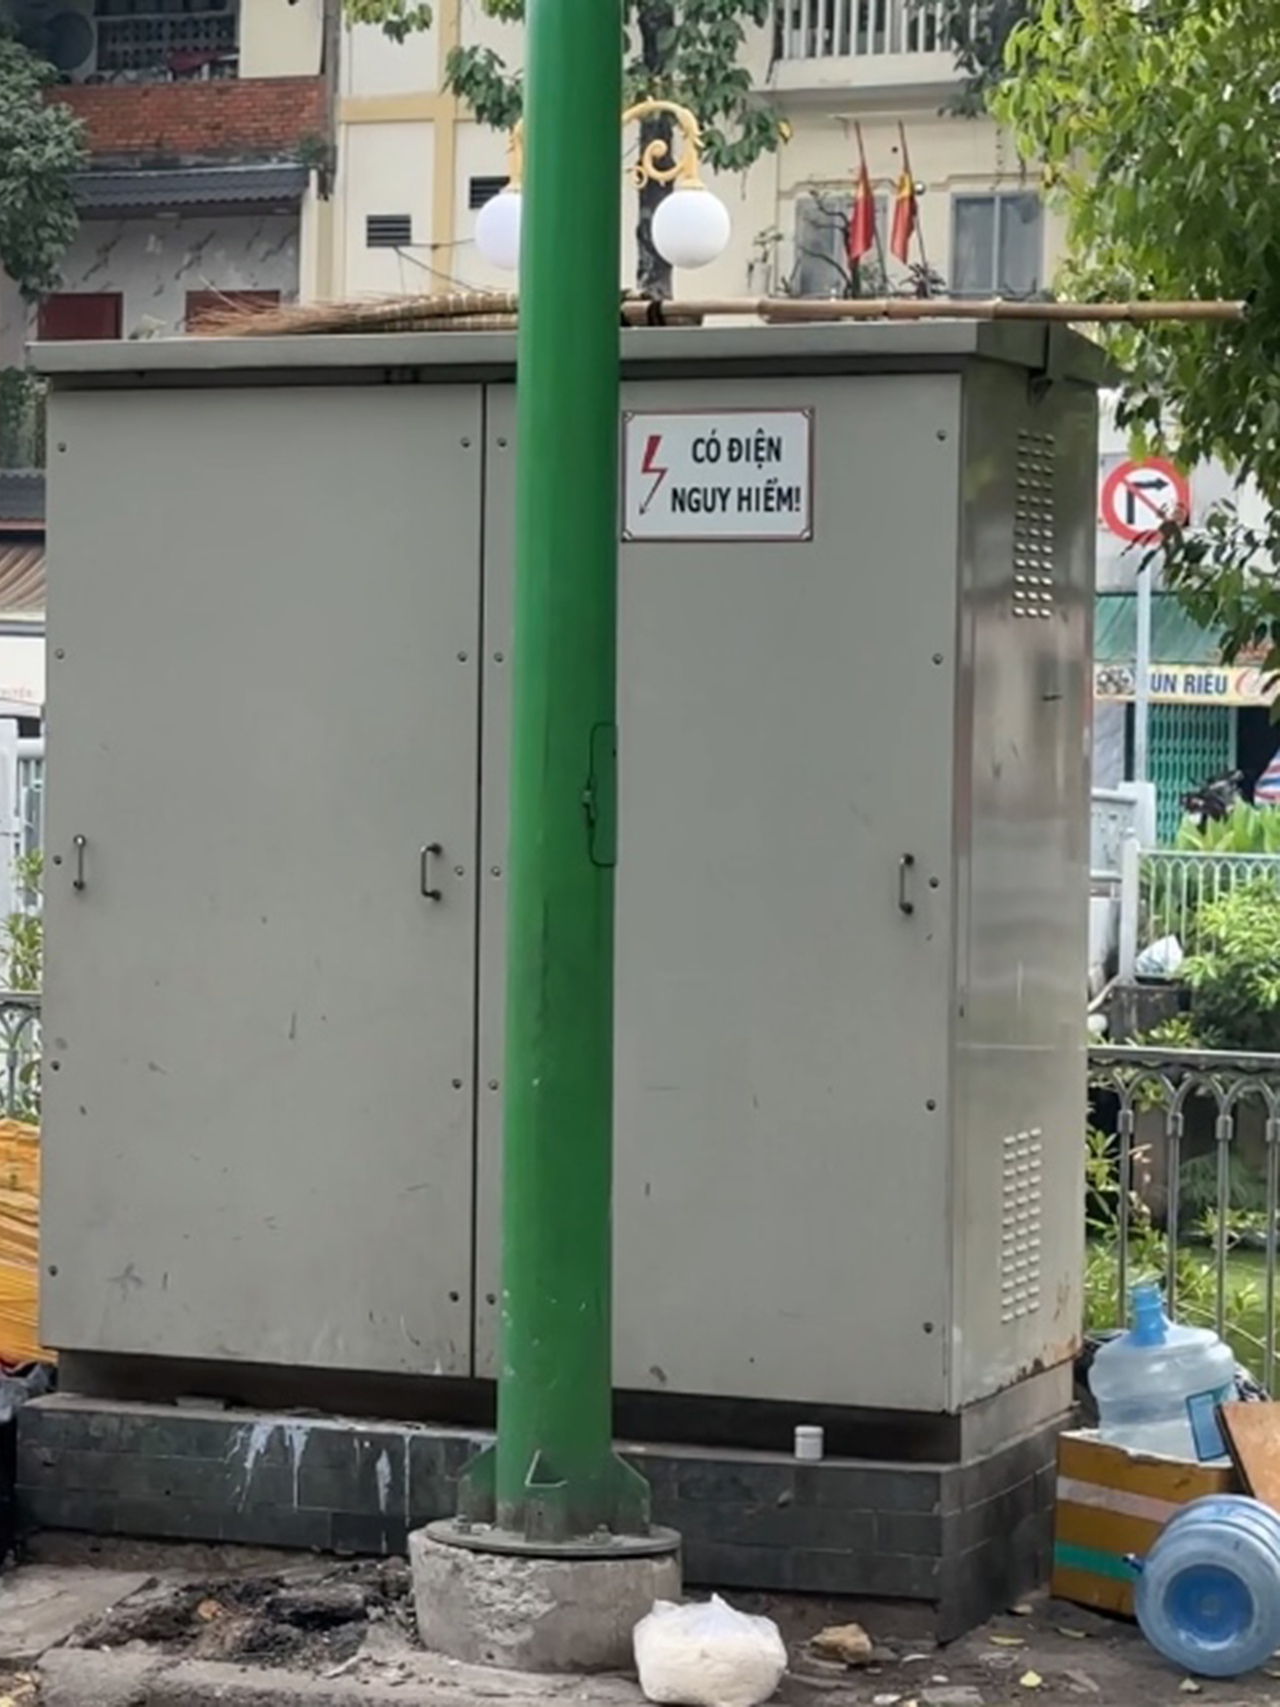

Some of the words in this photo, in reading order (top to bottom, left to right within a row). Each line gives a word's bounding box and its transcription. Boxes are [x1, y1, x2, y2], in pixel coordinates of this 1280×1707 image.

[691, 428, 721, 463] CÓ
[727, 427, 782, 470] ĐIỆN
[671, 486, 731, 514] NGUY
[737, 477, 801, 513] HIỂM!
